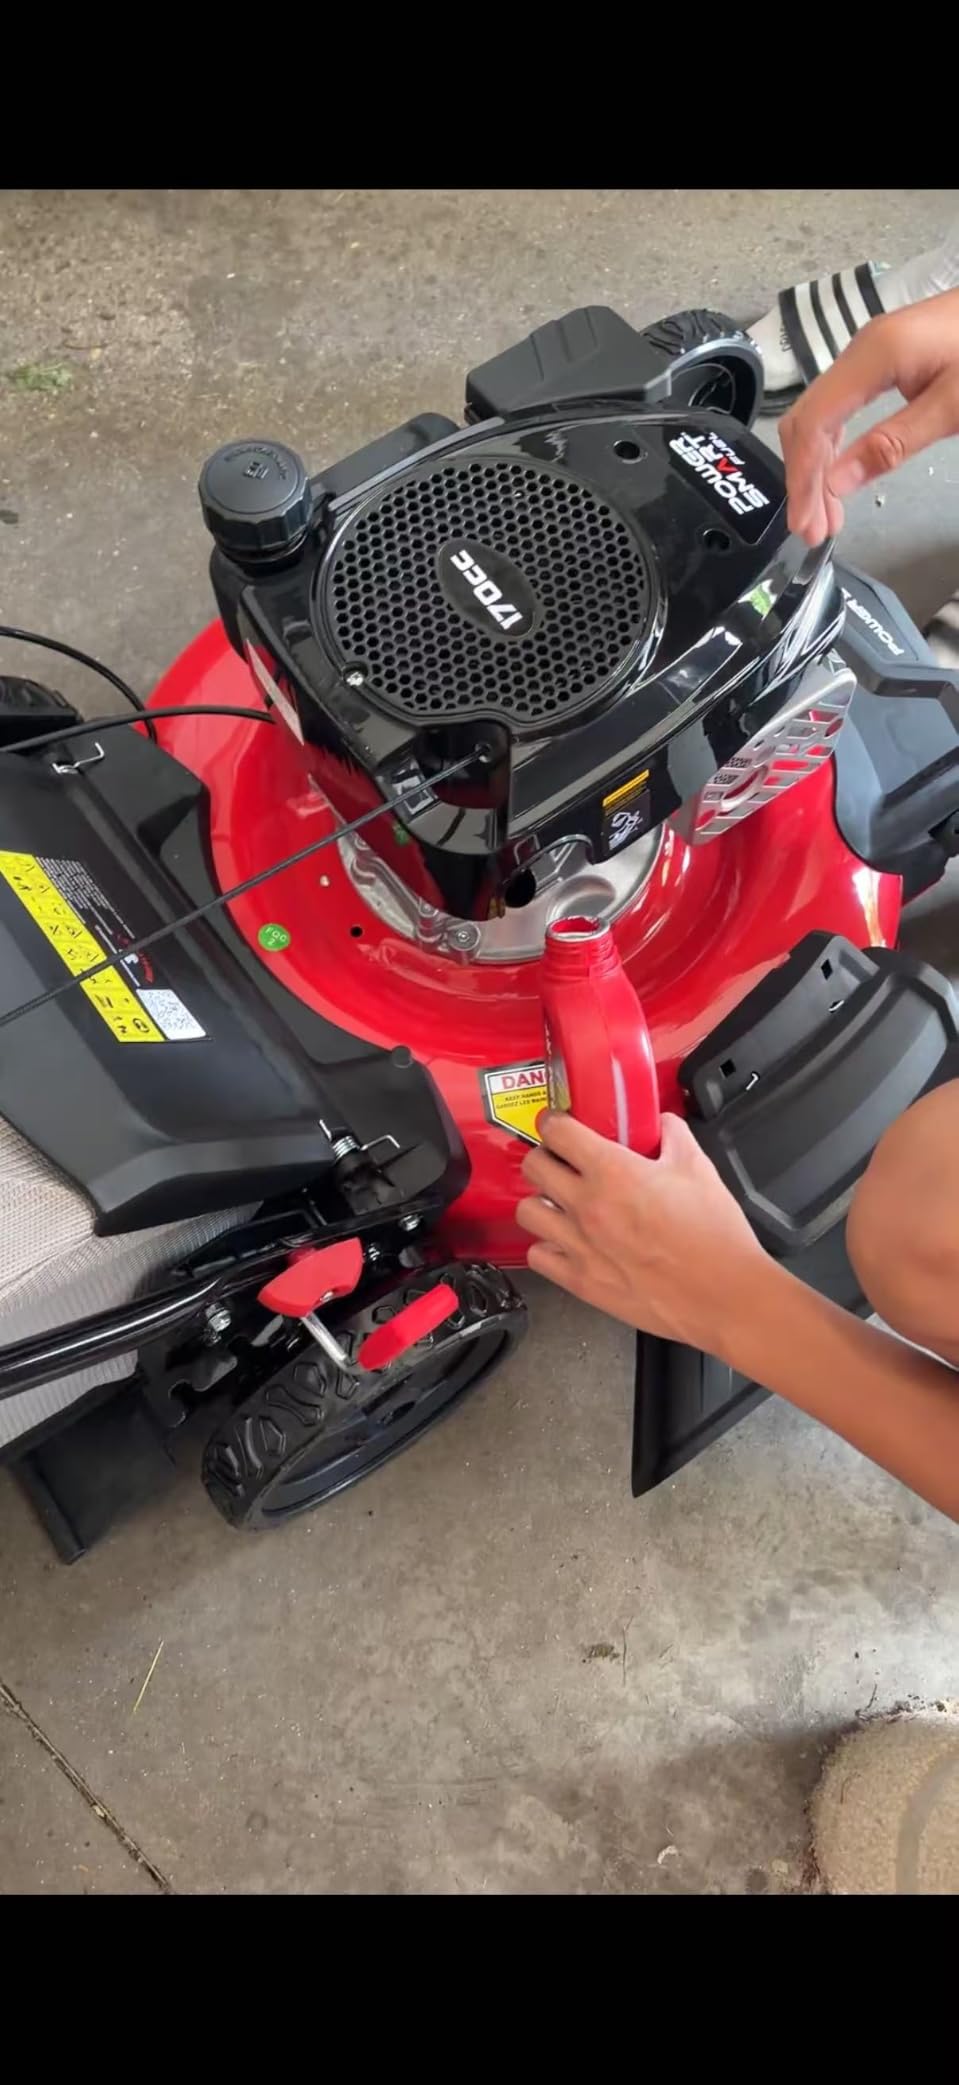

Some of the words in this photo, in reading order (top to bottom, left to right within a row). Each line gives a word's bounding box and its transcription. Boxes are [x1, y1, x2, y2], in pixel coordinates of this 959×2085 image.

[669, 437, 754, 515] POWER
[681, 432, 770, 508] SMART
[708, 432, 745, 465] FUEL
[450, 549, 523, 630] 170cc
[846, 598, 905, 656] POWER
